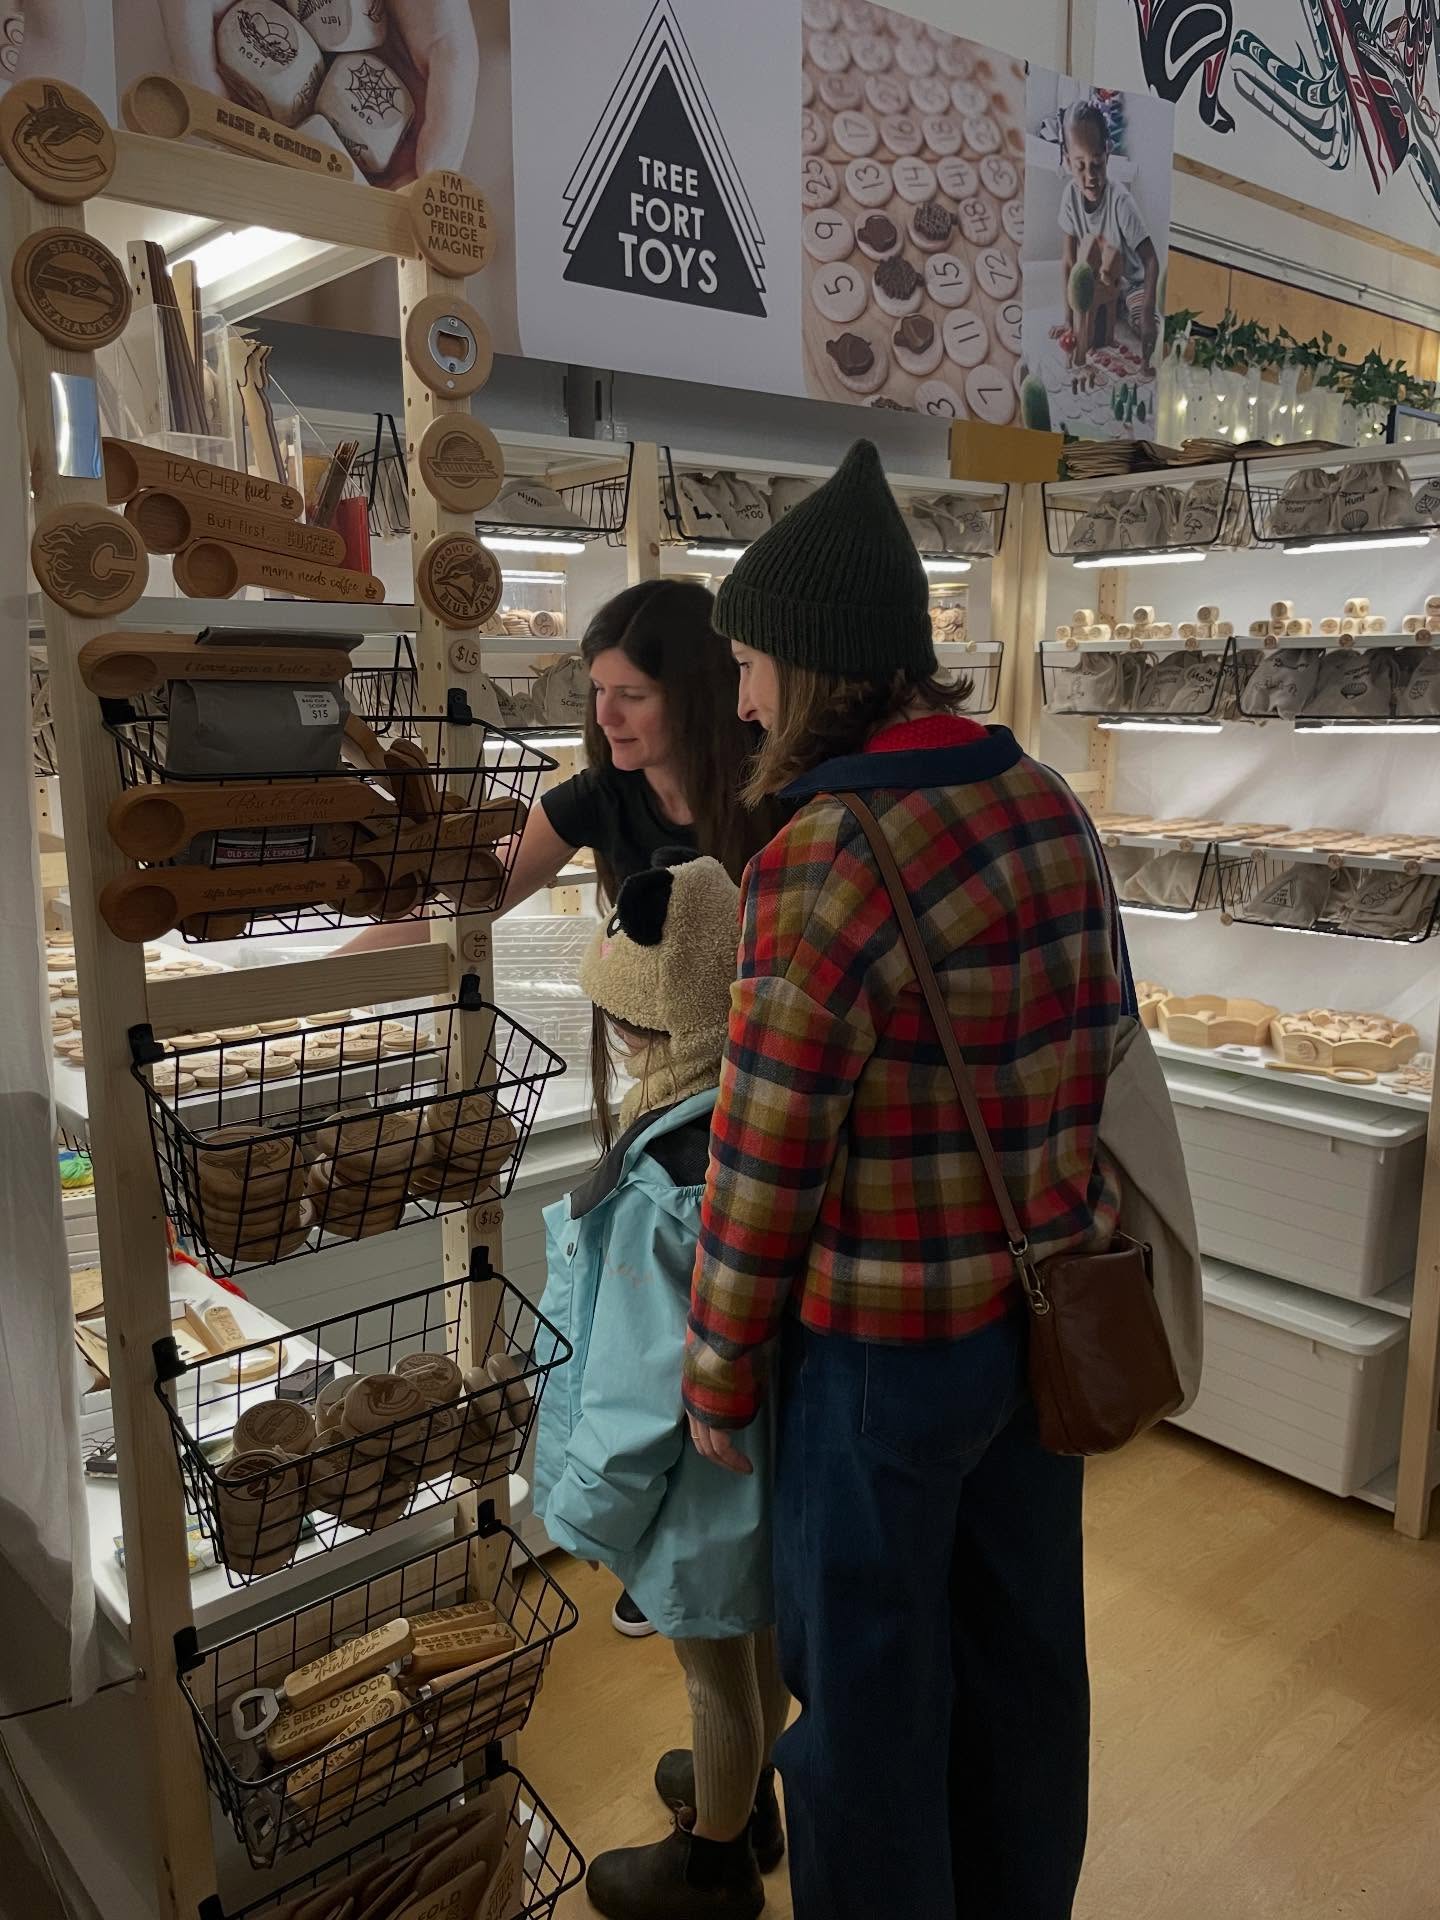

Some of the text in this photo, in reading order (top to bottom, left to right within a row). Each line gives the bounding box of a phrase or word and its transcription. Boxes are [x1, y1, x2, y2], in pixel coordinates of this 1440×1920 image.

[239, 46, 265, 68] nest
[351, 104, 373, 125] web
[217, 108, 322, 164] RISE & GRIND
[442, 175, 463, 192] I'M
[638, 155, 698, 198] TREE
[854, 164, 884, 190] 13
[901, 166, 928, 187] 14
[943, 164, 969, 188] 41
[425, 187, 485, 213] A BOTTLE
[422, 202, 487, 229] OPENER &
[630, 192, 705, 241] FORT
[963, 201, 991, 233] 48
[430, 220, 478, 242] FRIDGE
[48, 241, 113, 273] SEATTLE
[428, 236, 485, 259] MAGNET
[618, 231, 718, 294] TOYS
[933, 261, 964, 287] 15
[823, 274, 854, 296] 5
[39, 298, 113, 334] SEAHAWKS
[952, 320, 980, 345] 11
[976, 387, 1003, 405] 7
[166, 460, 271, 502] TEACHER fuel
[207, 512, 232, 530] But
[434, 543, 473, 575] TORONTO
[261, 564, 359, 595] mama needs coffee
[440, 585, 495, 616] BLUE JAYS
[455, 645, 479, 666] $15
[311, 709, 329, 720] $15
[473, 933, 488, 958] $15
[479, 1209, 501, 1226] $15
[301, 1625, 391, 1676] SAVE WATER
[314, 1654, 351, 1682] drink
[266, 1675, 387, 1738] IT'S BEER O'CLOCK
[278, 1694, 379, 1745] somewhere
